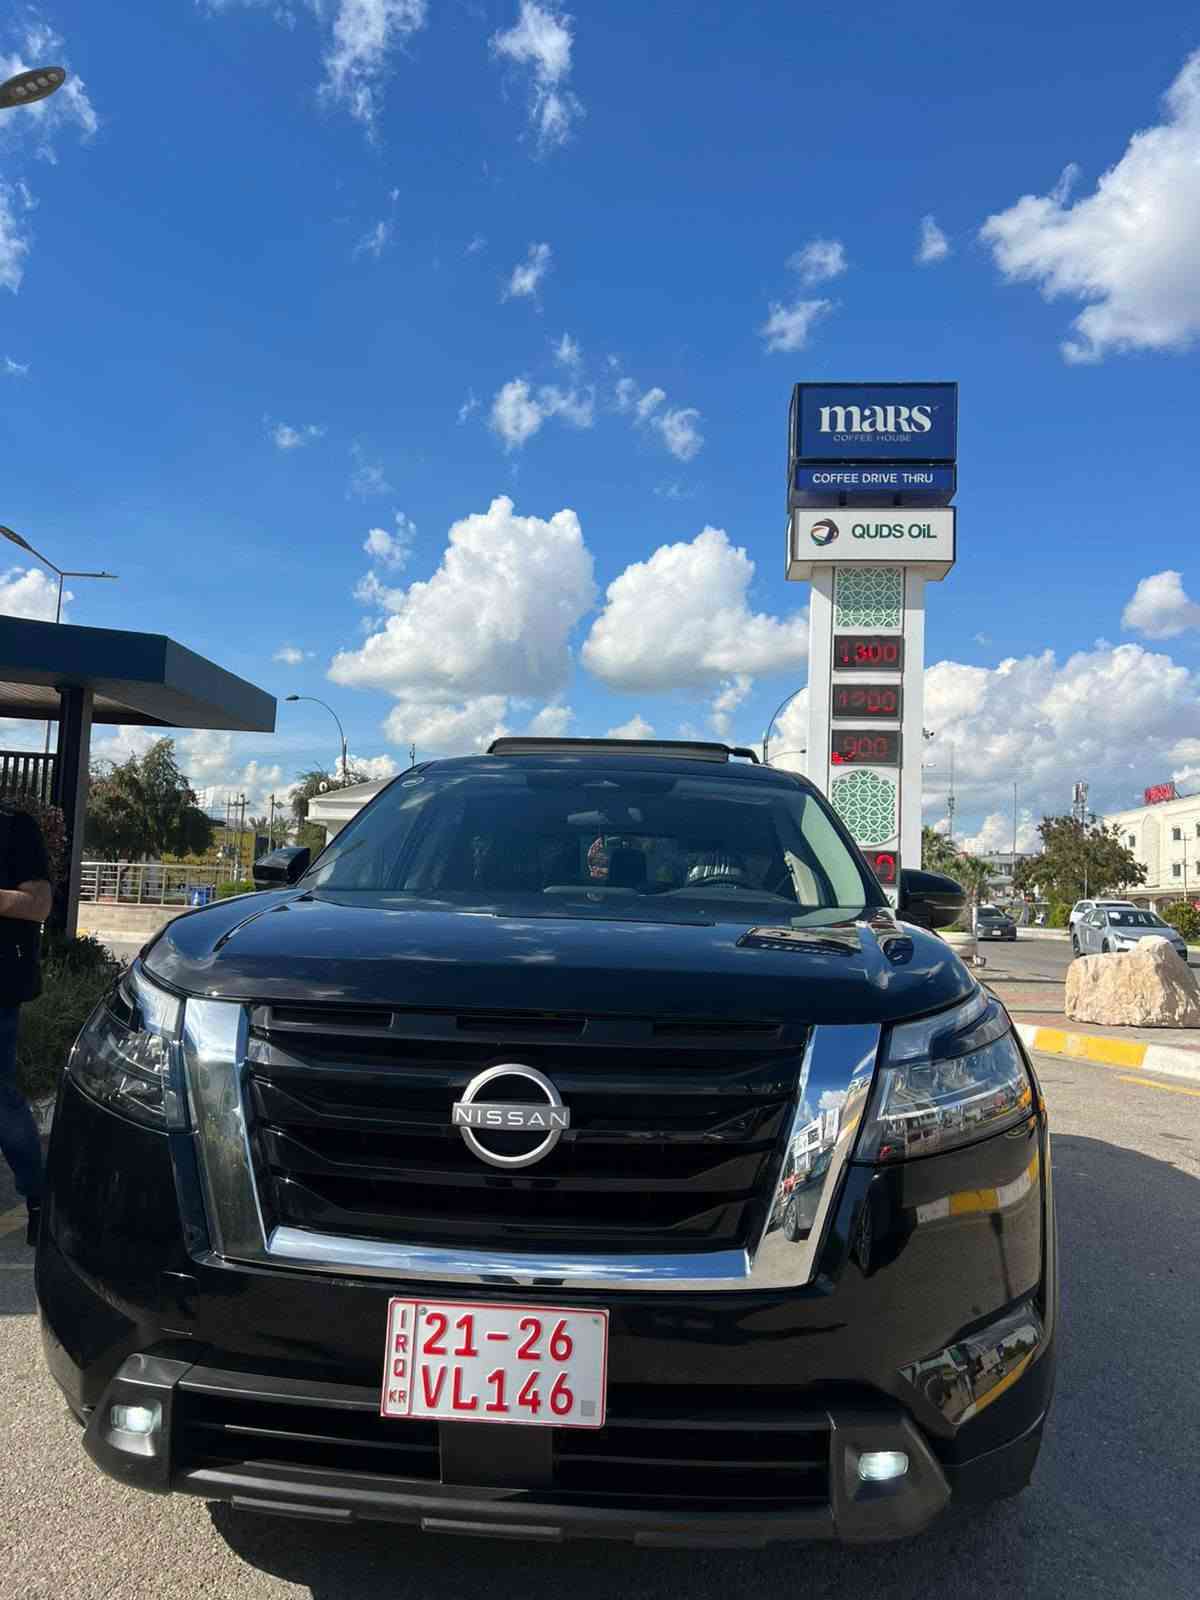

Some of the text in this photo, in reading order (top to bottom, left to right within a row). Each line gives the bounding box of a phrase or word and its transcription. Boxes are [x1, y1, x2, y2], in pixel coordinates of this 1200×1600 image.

[833, 433, 912, 442] COFFEE HOUSE
[812, 473, 934, 484] COFFEE DRIVE THRU
[851, 523, 905, 540] QUDS
[456, 1108, 567, 1126] NISSAN
[422, 1312, 574, 1362] 21-26
[388, 1389, 407, 1403] KR
[420, 1364, 574, 1415] VL146
